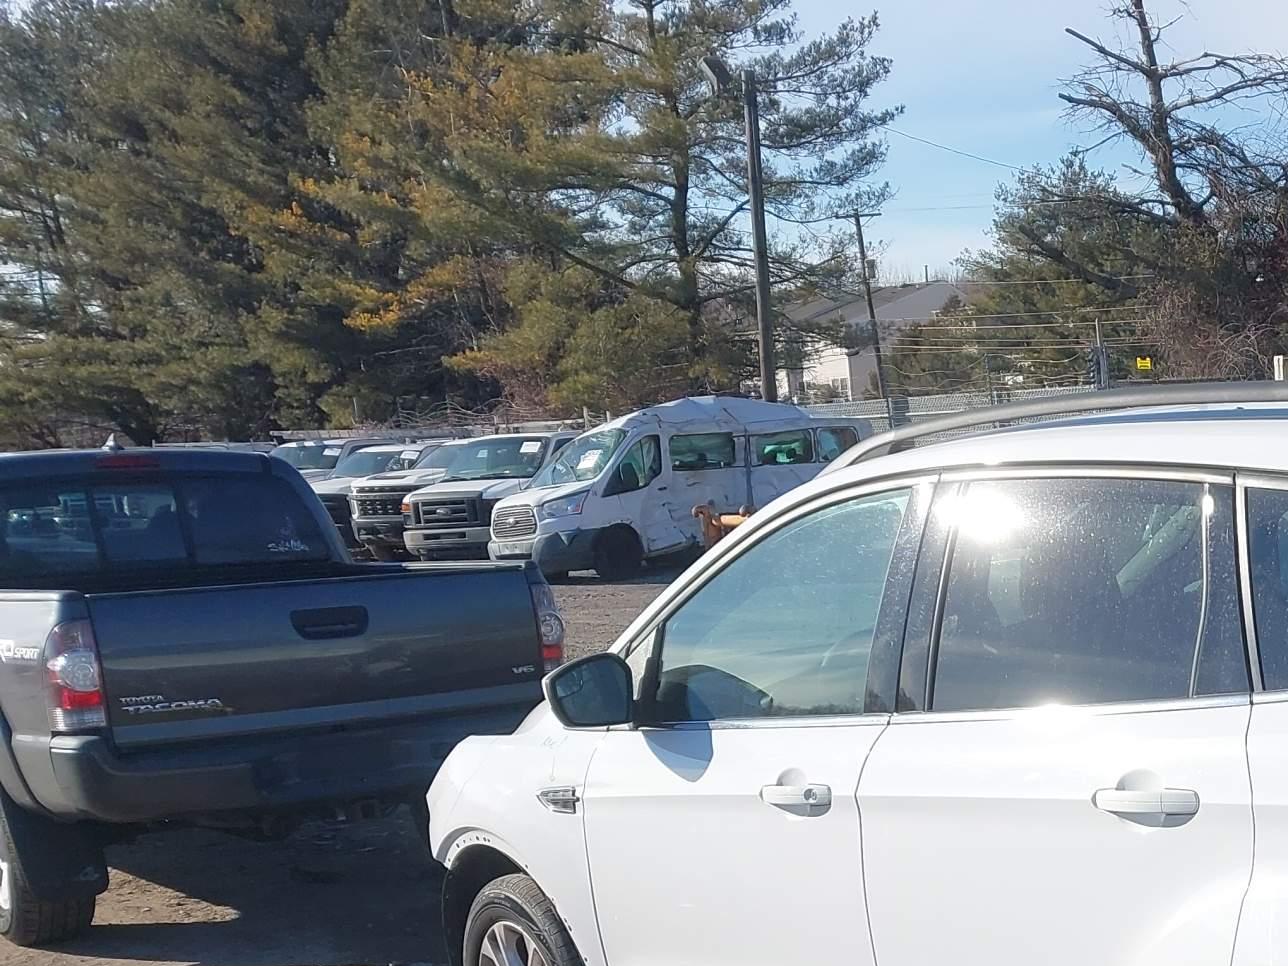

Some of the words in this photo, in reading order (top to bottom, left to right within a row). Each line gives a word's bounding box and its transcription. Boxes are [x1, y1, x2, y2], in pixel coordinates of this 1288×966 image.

[14, 647, 40, 659] SPORT
[119, 695, 164, 705] TOYOTA
[121, 698, 224, 715] TACOMA
